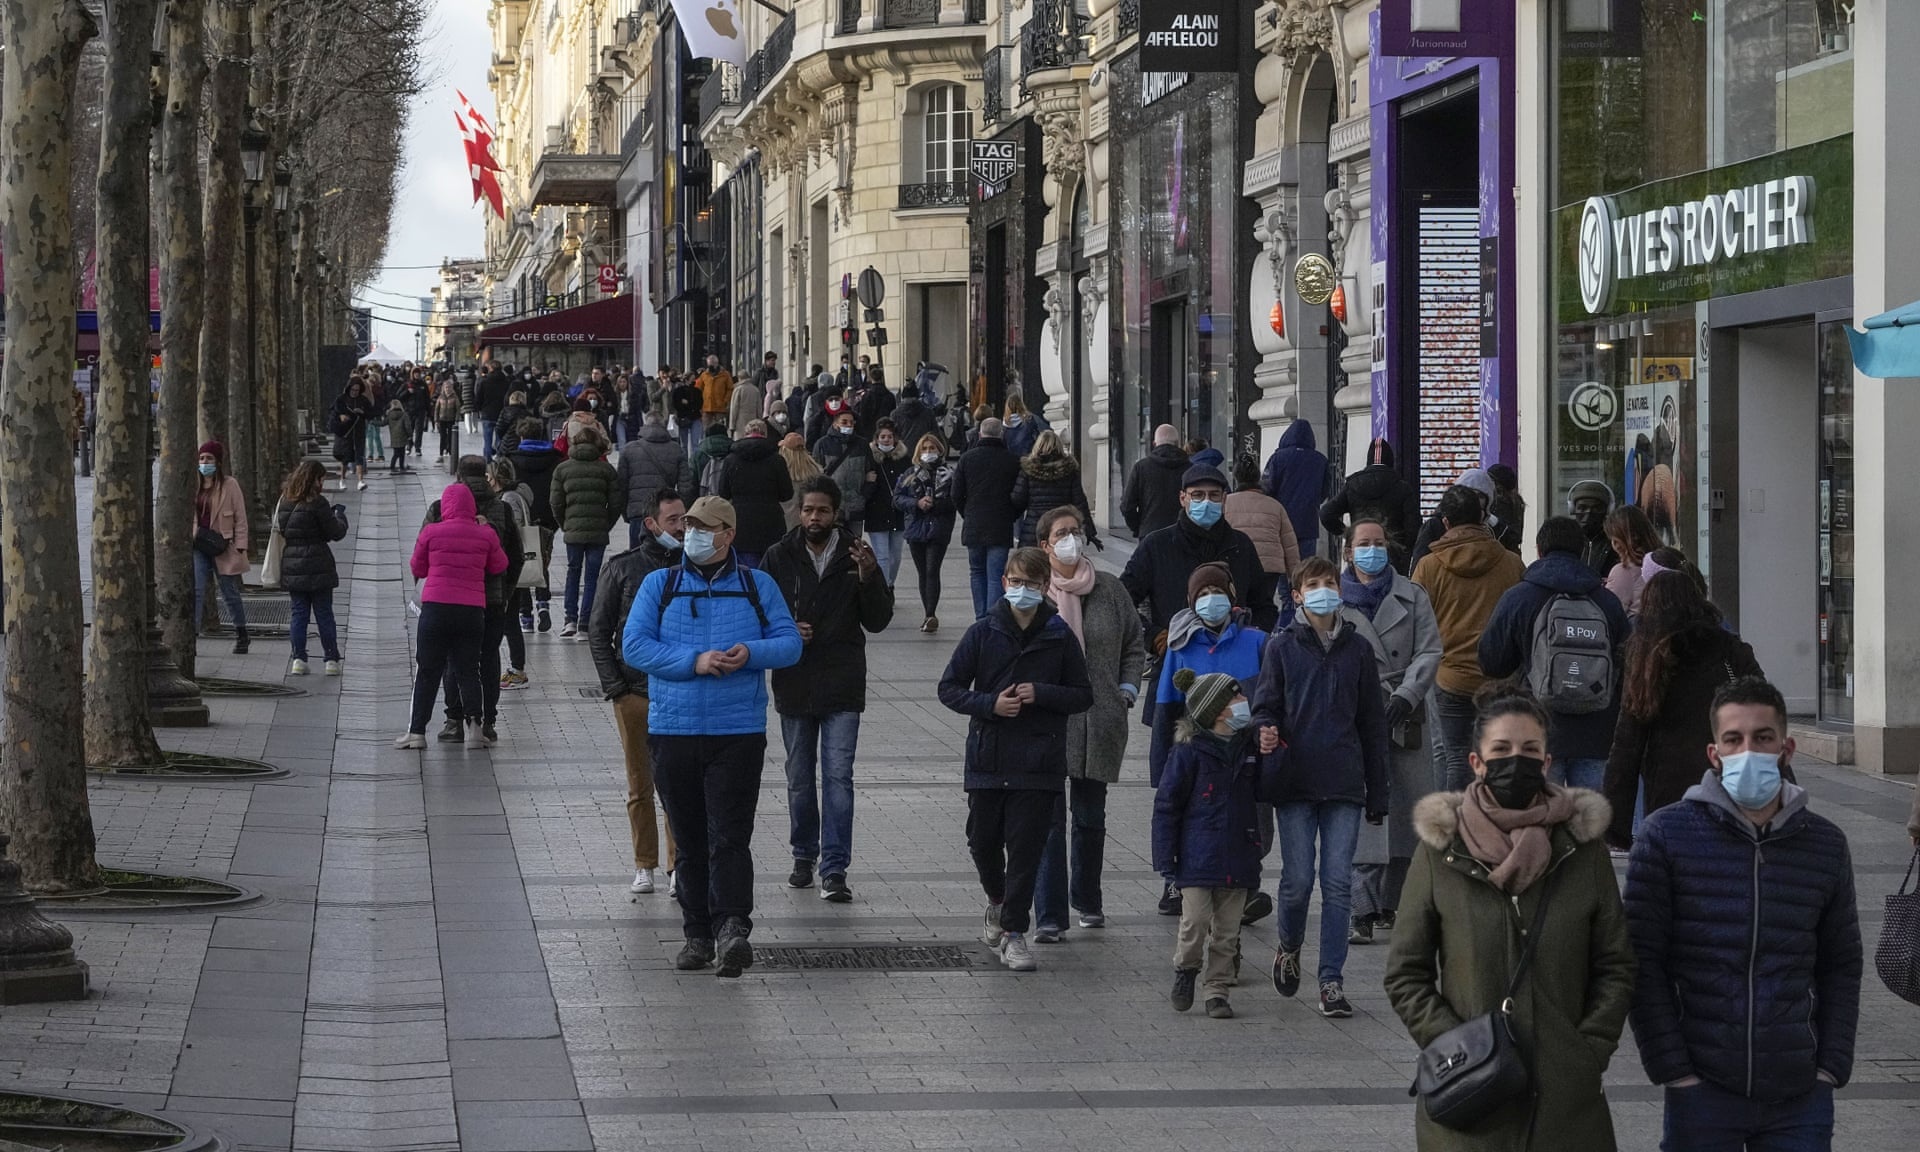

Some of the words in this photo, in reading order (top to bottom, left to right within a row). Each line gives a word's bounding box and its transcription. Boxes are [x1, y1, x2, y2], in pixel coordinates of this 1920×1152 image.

[1171, 14, 1218, 29] ALAIN
[1144, 31, 1218, 47] AFFLELOU
[1407, 37, 1467, 50] Marionnaud
[975, 144, 1012, 157] TAG
[974, 161, 1013, 182] HEUER
[1613, 206, 1679, 280] YVES
[1684, 175, 1809, 267] ROCHER
[603, 267, 615, 281] Q
[512, 333, 540, 341] CAFE
[542, 333, 585, 342] GEORGE
[1558, 444, 1581, 452] YVES
[1567, 626, 1575, 637] R
[1577, 627, 1597, 640] Pay
